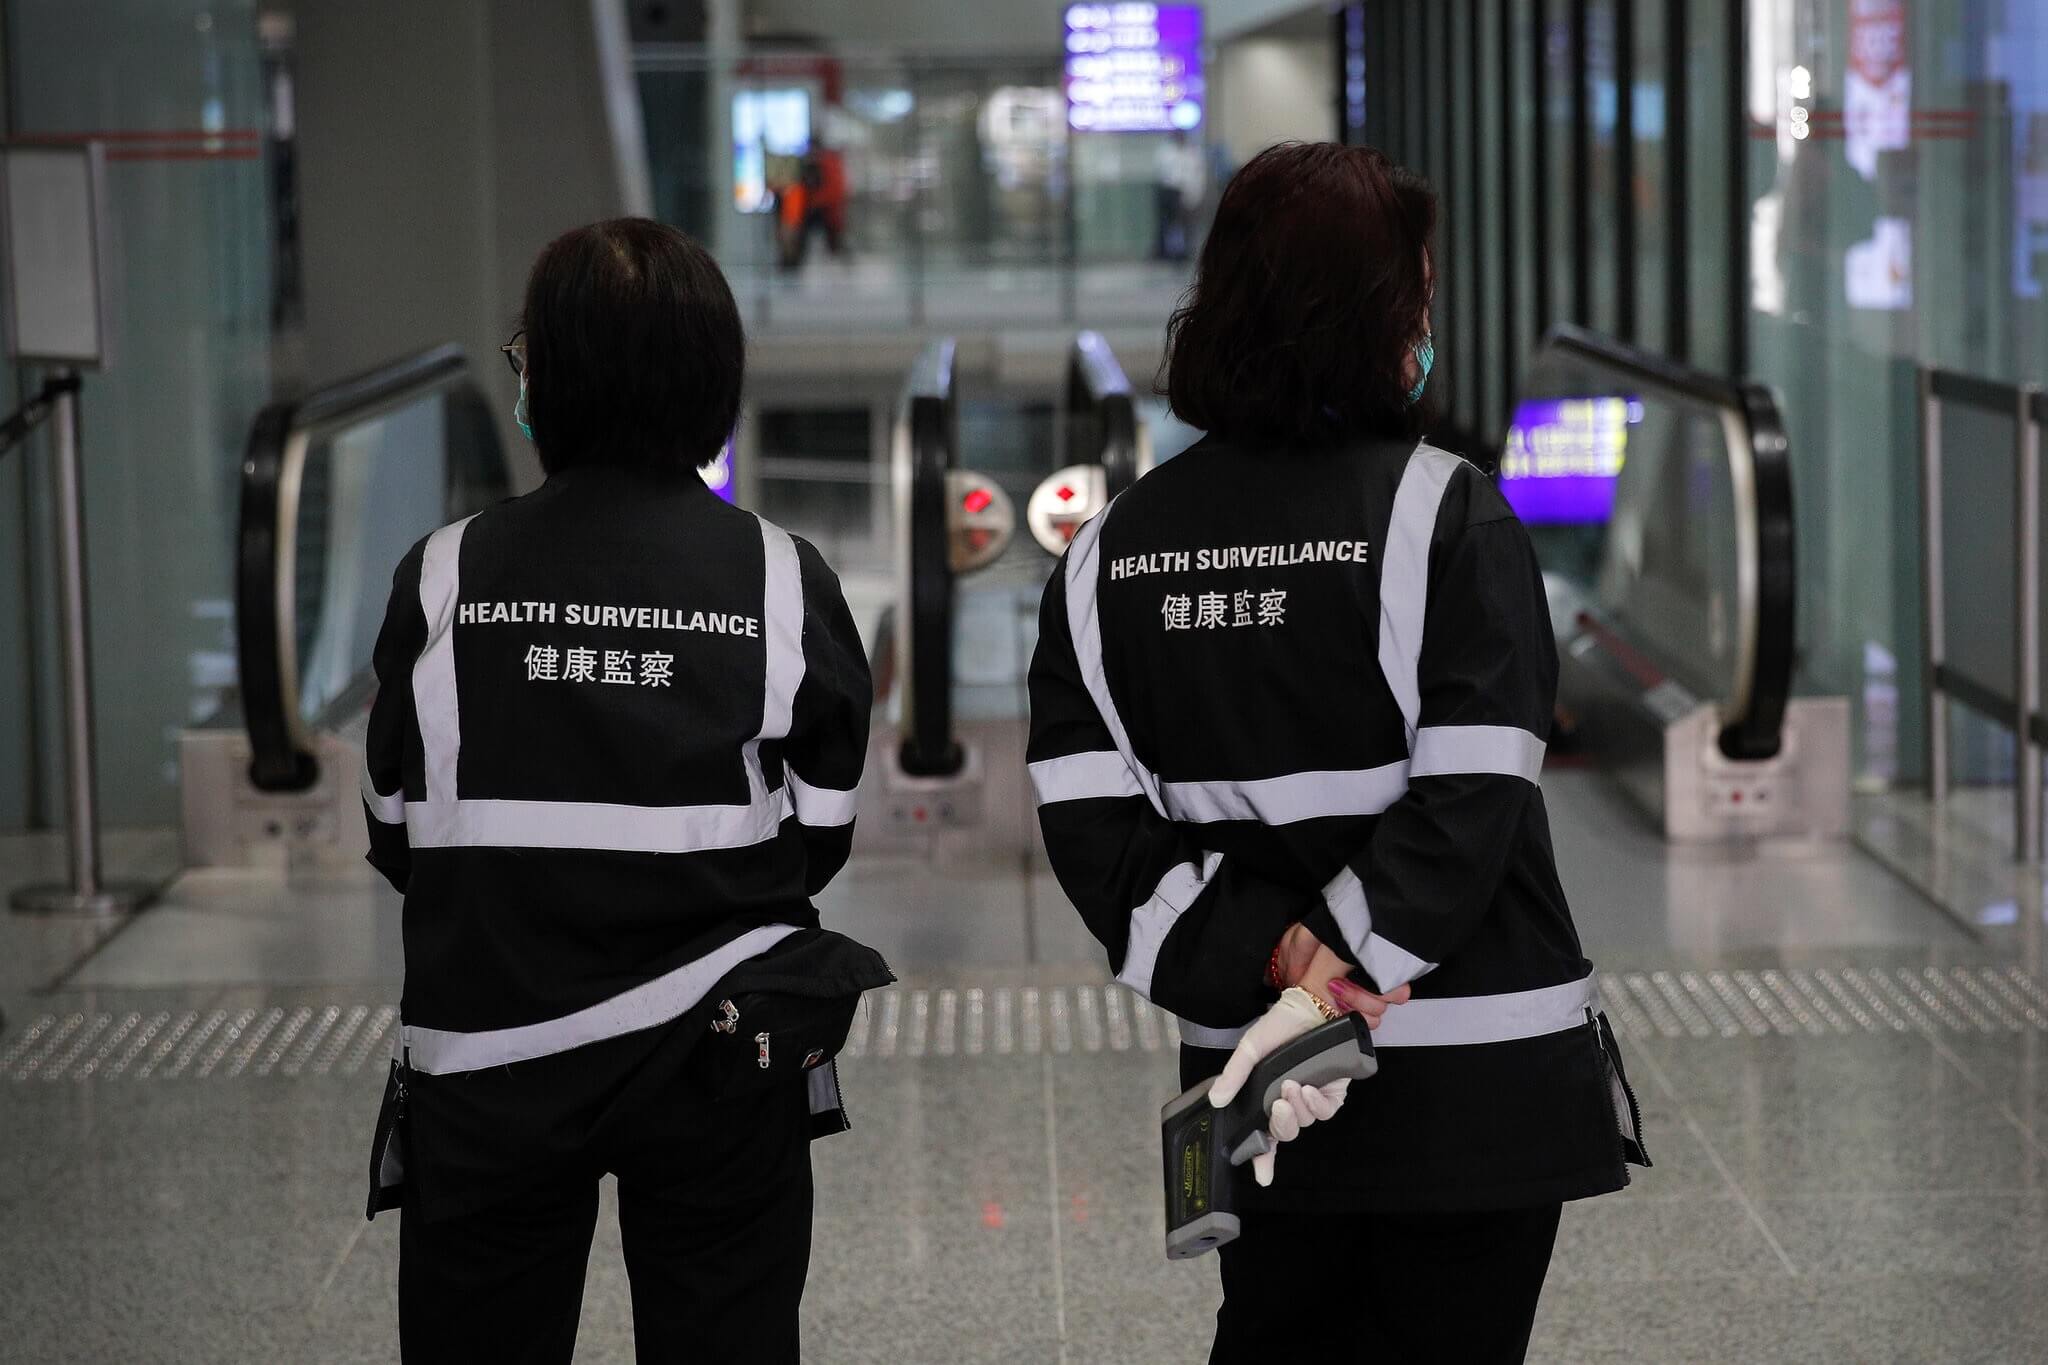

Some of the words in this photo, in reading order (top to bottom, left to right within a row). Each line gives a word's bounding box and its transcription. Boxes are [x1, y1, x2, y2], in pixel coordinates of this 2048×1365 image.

[1110, 551, 1190, 581] HEALTH
[1196, 541, 1369, 570] SURVEILLANCE
[459, 602, 556, 625] HEALTH
[564, 603, 760, 638] SURVEILLANCE
[1160, 588, 1287, 631] 健康監察
[523, 644, 675, 688] 健康監察
